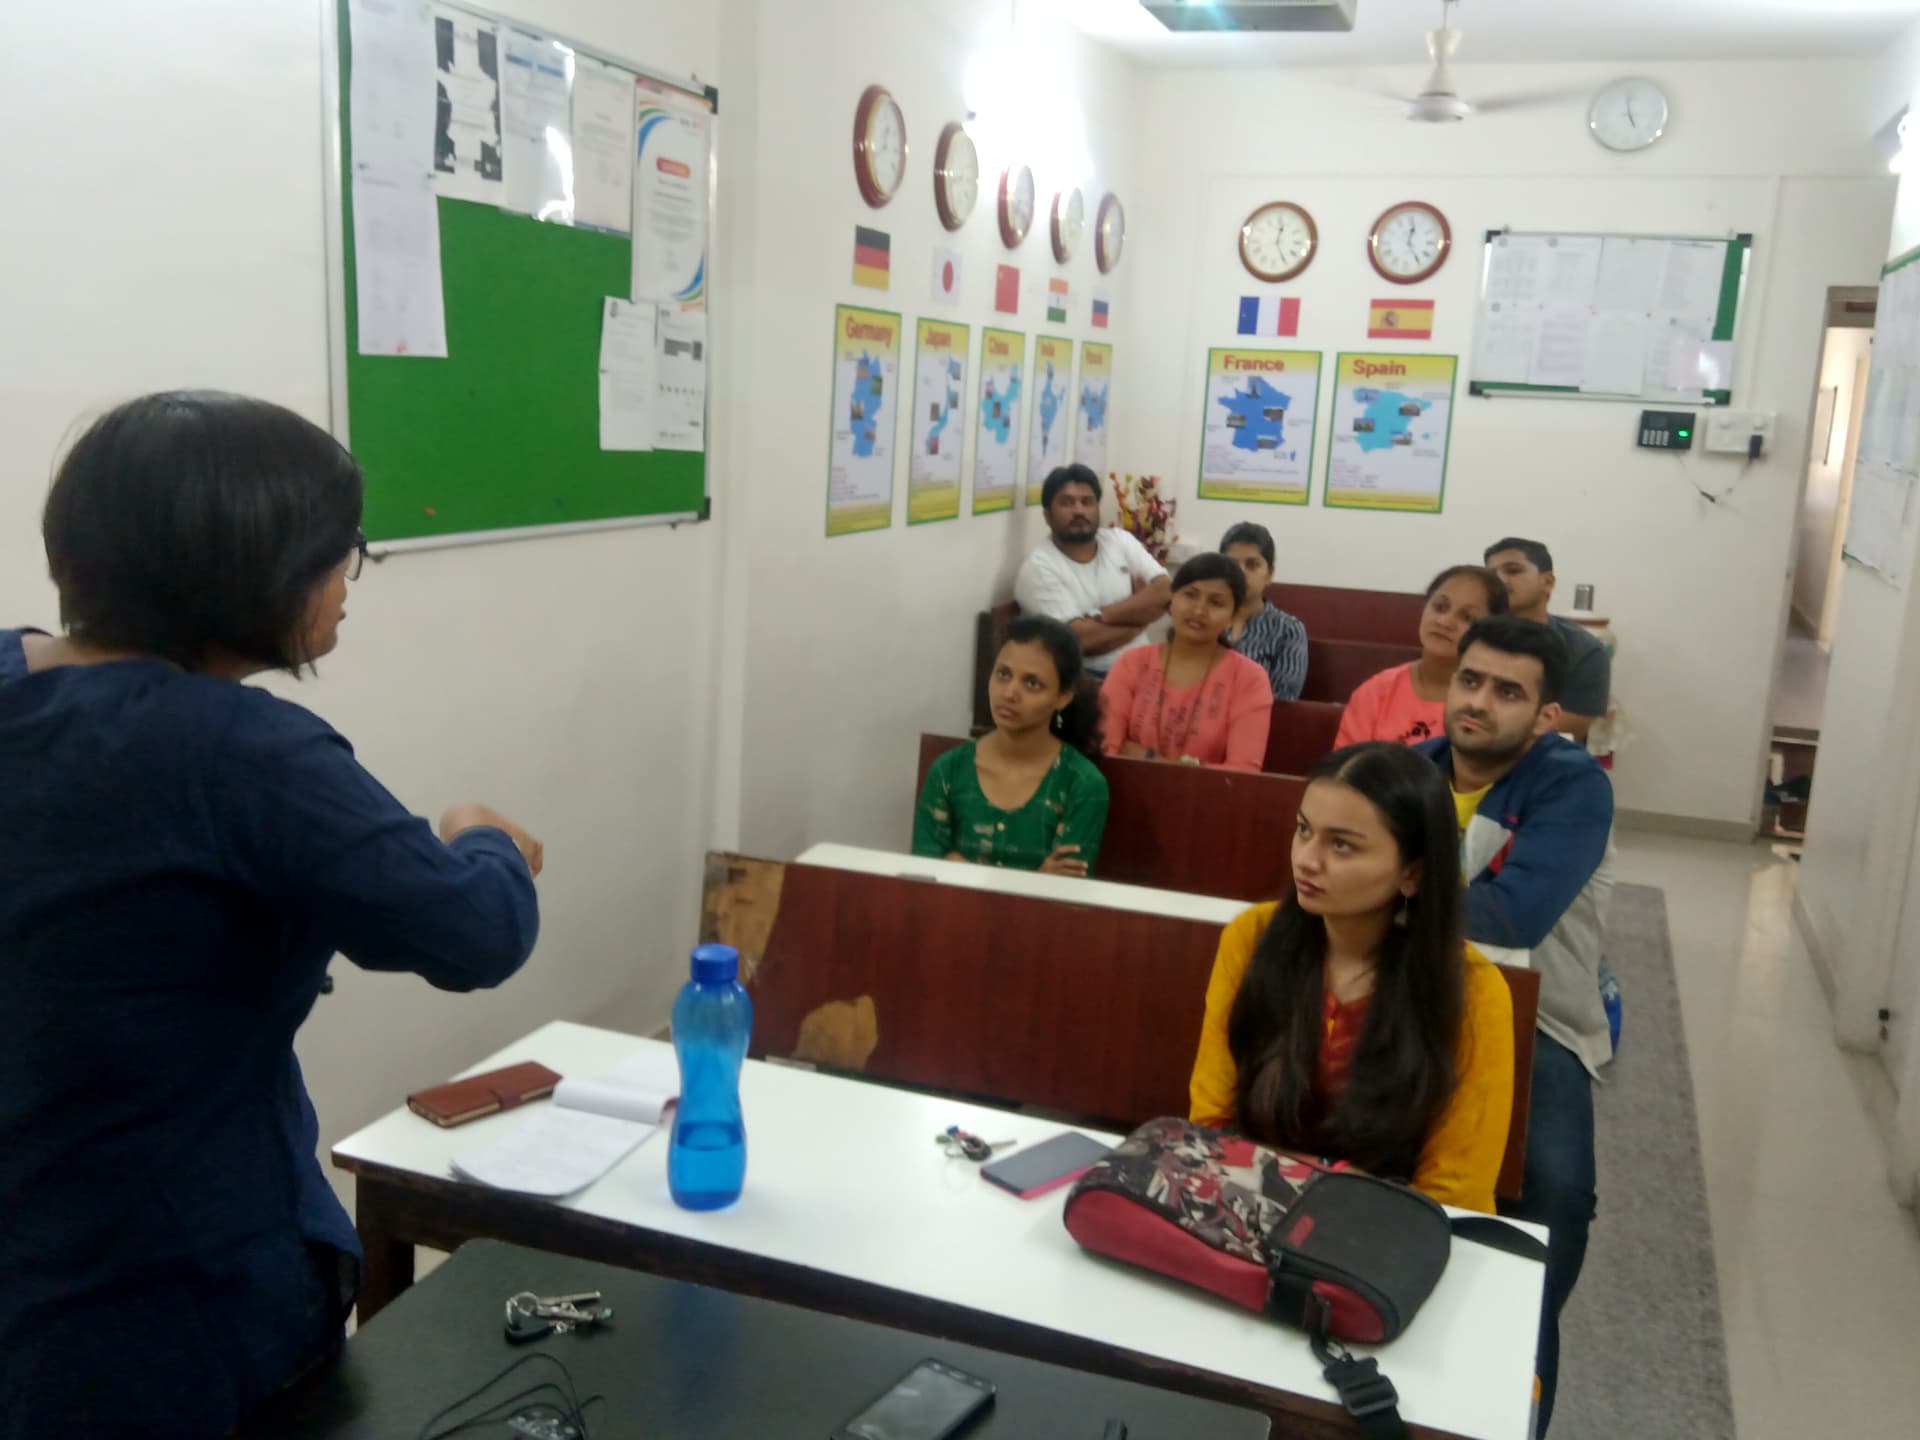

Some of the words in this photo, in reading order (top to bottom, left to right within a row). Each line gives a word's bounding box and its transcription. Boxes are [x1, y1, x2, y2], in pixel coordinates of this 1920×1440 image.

[846, 317, 892, 347] Germany
[926, 328, 952, 350] Japan
[988, 335, 1009, 355] China
[1223, 354, 1286, 371] France
[1353, 359, 1407, 378] Spain
